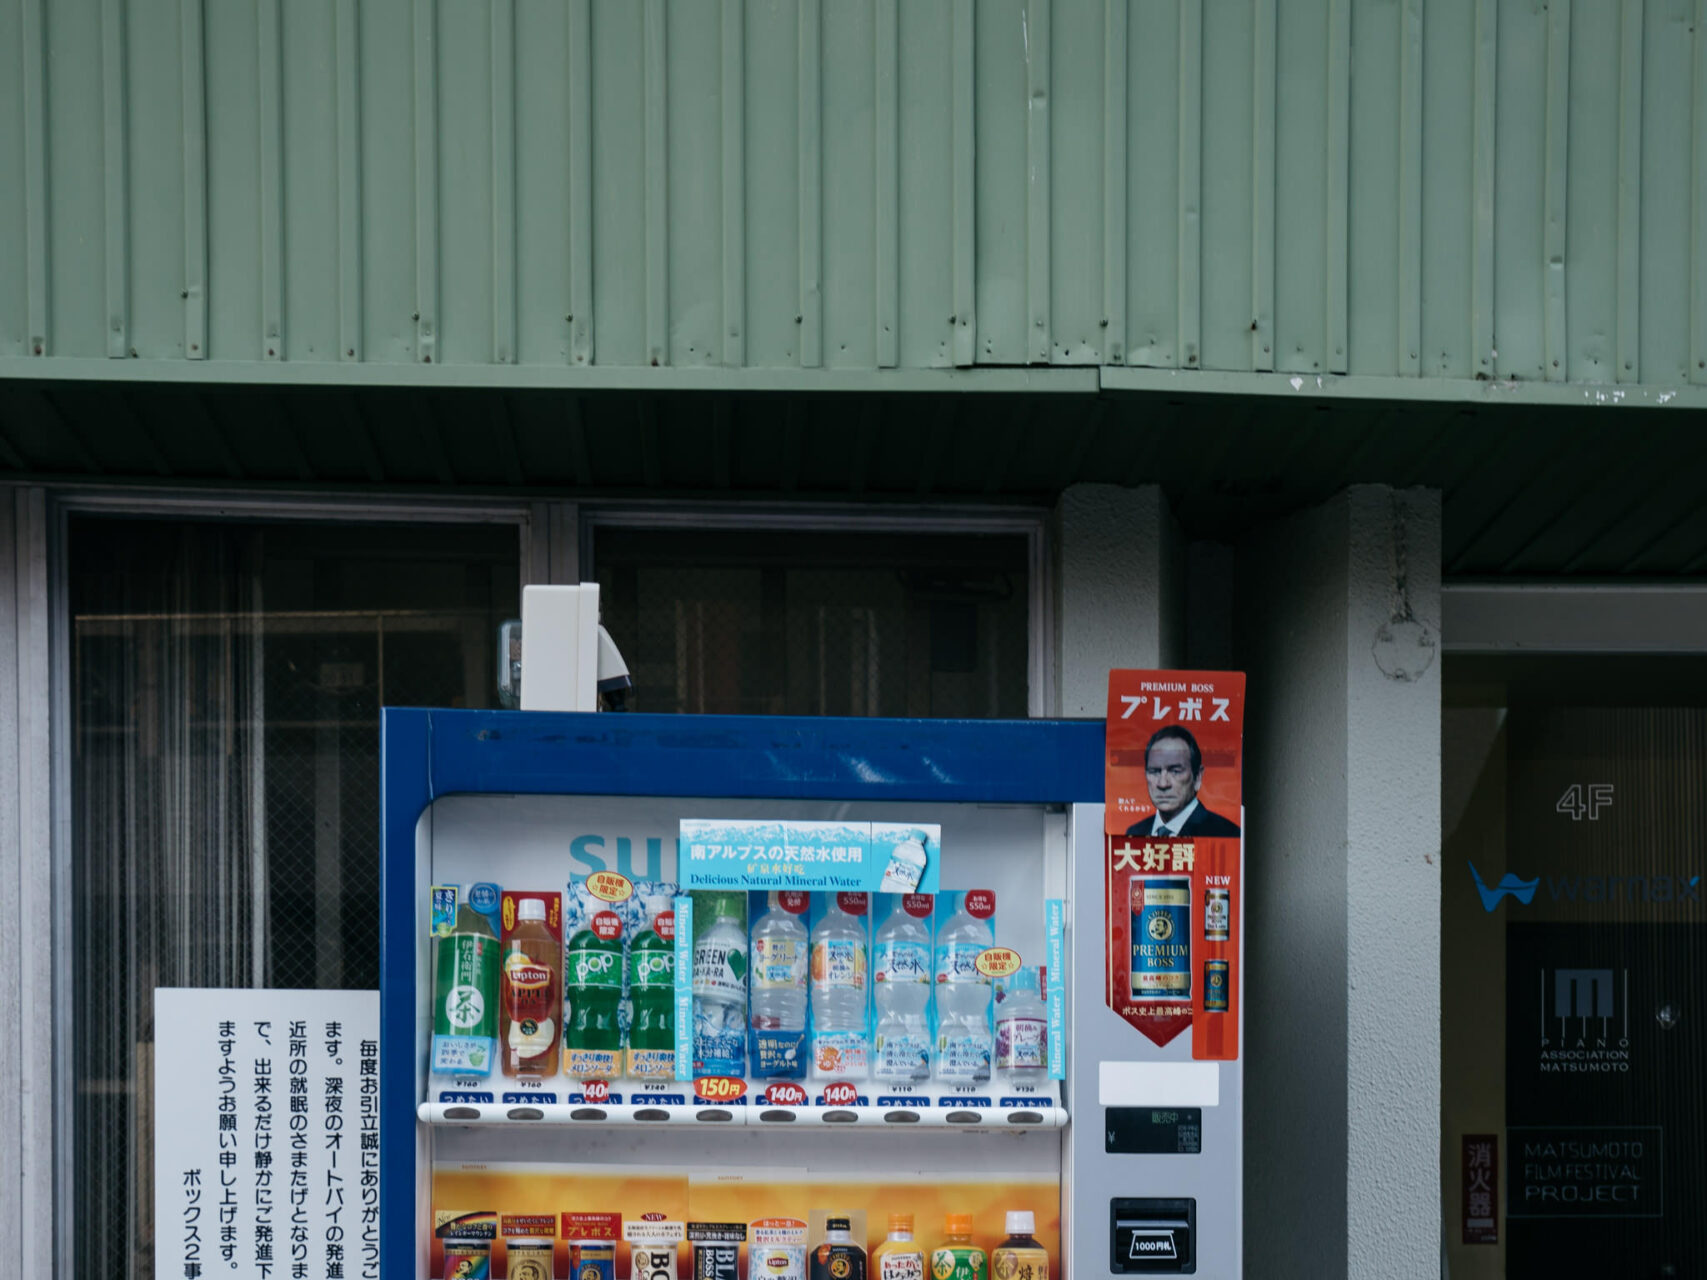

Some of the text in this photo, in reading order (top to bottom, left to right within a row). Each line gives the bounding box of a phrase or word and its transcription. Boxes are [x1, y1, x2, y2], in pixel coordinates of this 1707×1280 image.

[1140, 682, 1215, 693] PREMIUM BOSS
[1120, 695, 1231, 722] プレボス
[1556, 784, 1614, 821] 4F
[691, 844, 863, 863] 南アルプスの天然水使用
[1113, 842, 1195, 872] 大好評
[690, 874, 862, 888] Delicious Natural Mineral Water
[1205, 875, 1231, 886] NEW
[599, 885, 617, 897] 限定
[969, 902, 991, 911] 550ml
[599, 926, 615, 936] 限定
[985, 952, 1011, 961] 自販機
[1133, 945, 1188, 956] PREMIUM
[575, 953, 614, 979] pop
[988, 962, 1007, 971] 限定
[1147, 957, 1175, 967] BOSS
[512, 970, 547, 981] Lipton
[679, 903, 689, 1076] Mineral Water Mineral Water
[1050, 904, 1062, 1075] Mineral Water Mineral Water
[450, 990, 480, 1024] 茶
[1541, 1038, 1629, 1048] PIANO
[1540, 1050, 1629, 1060] ASSOCIATION
[1540, 1062, 1630, 1072] MATSUMOTO
[700, 1079, 741, 1096] 150円
[770, 1086, 802, 1101] 140円
[218, 1020, 239, 1270] ますようお願い申し上げます。
[1525, 1142, 1643, 1159] MATSUMOTO
[1565, 1163, 1642, 1180] FESTIVAL
[1468, 1143, 1492, 1217] 消火器
[1525, 1185, 1641, 1201] PROJECT
[645, 1213, 662, 1221] NEW
[705, 1250, 715, 1277] BOSS
[934, 1251, 952, 1277] 茶
